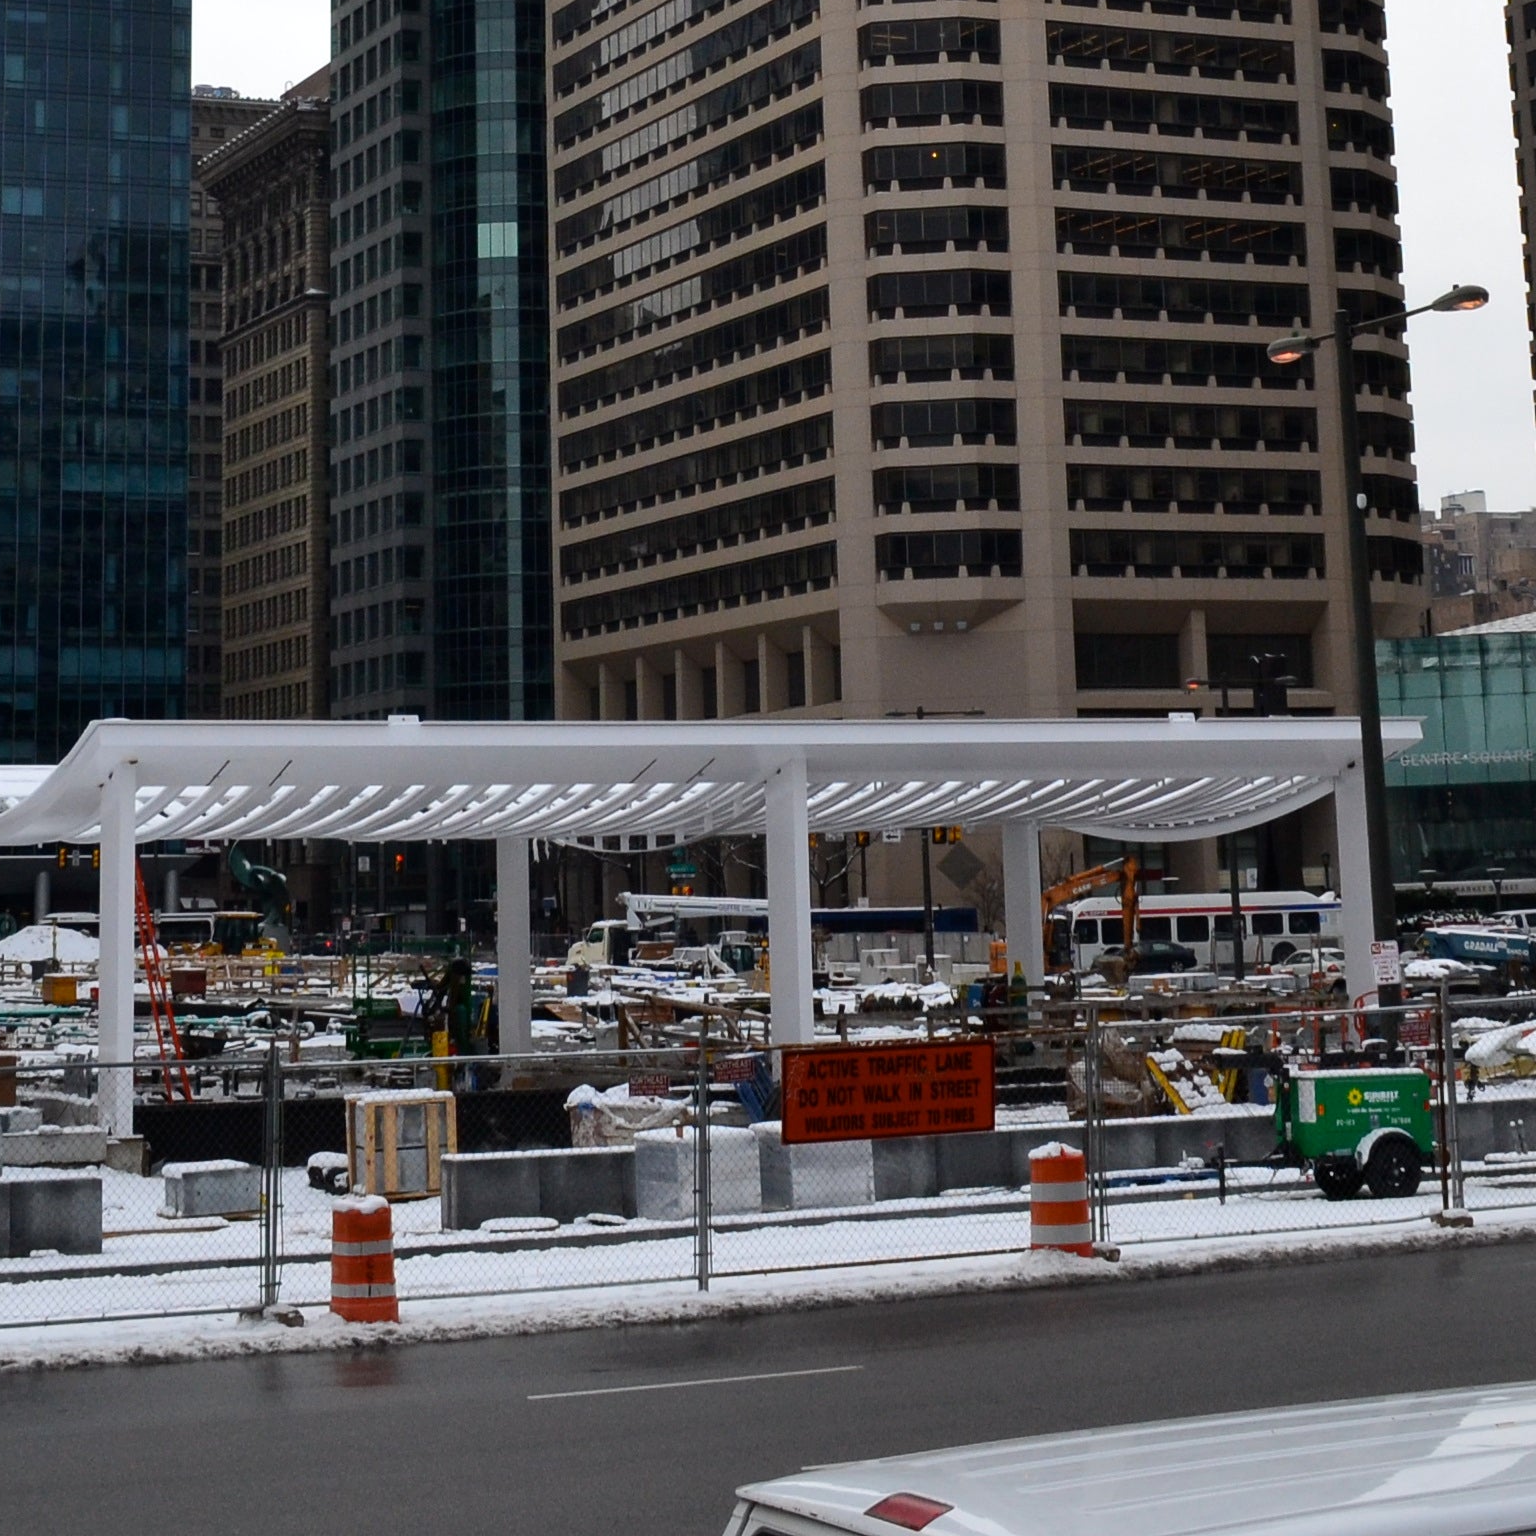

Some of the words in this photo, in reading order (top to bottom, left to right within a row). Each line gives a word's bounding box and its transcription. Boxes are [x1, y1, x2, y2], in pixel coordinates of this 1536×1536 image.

[1400, 751, 1462, 767] CENTRE
[1468, 749, 1534, 764] SQUARE
[807, 1058, 860, 1080] ACTIVE
[867, 1054, 928, 1077] TRAFFIC
[935, 1051, 974, 1073] LANE
[799, 1088, 819, 1109] DO
[827, 1085, 857, 1107] NOT
[864, 1082, 901, 1103] WALK
[910, 1081, 923, 1102] IN
[931, 1079, 982, 1101] STREET
[805, 1114, 865, 1135] VIOLATORS
[871, 1112, 920, 1131] SUBJECT
[928, 1111, 939, 1127] TO
[944, 1108, 975, 1125] FINES
